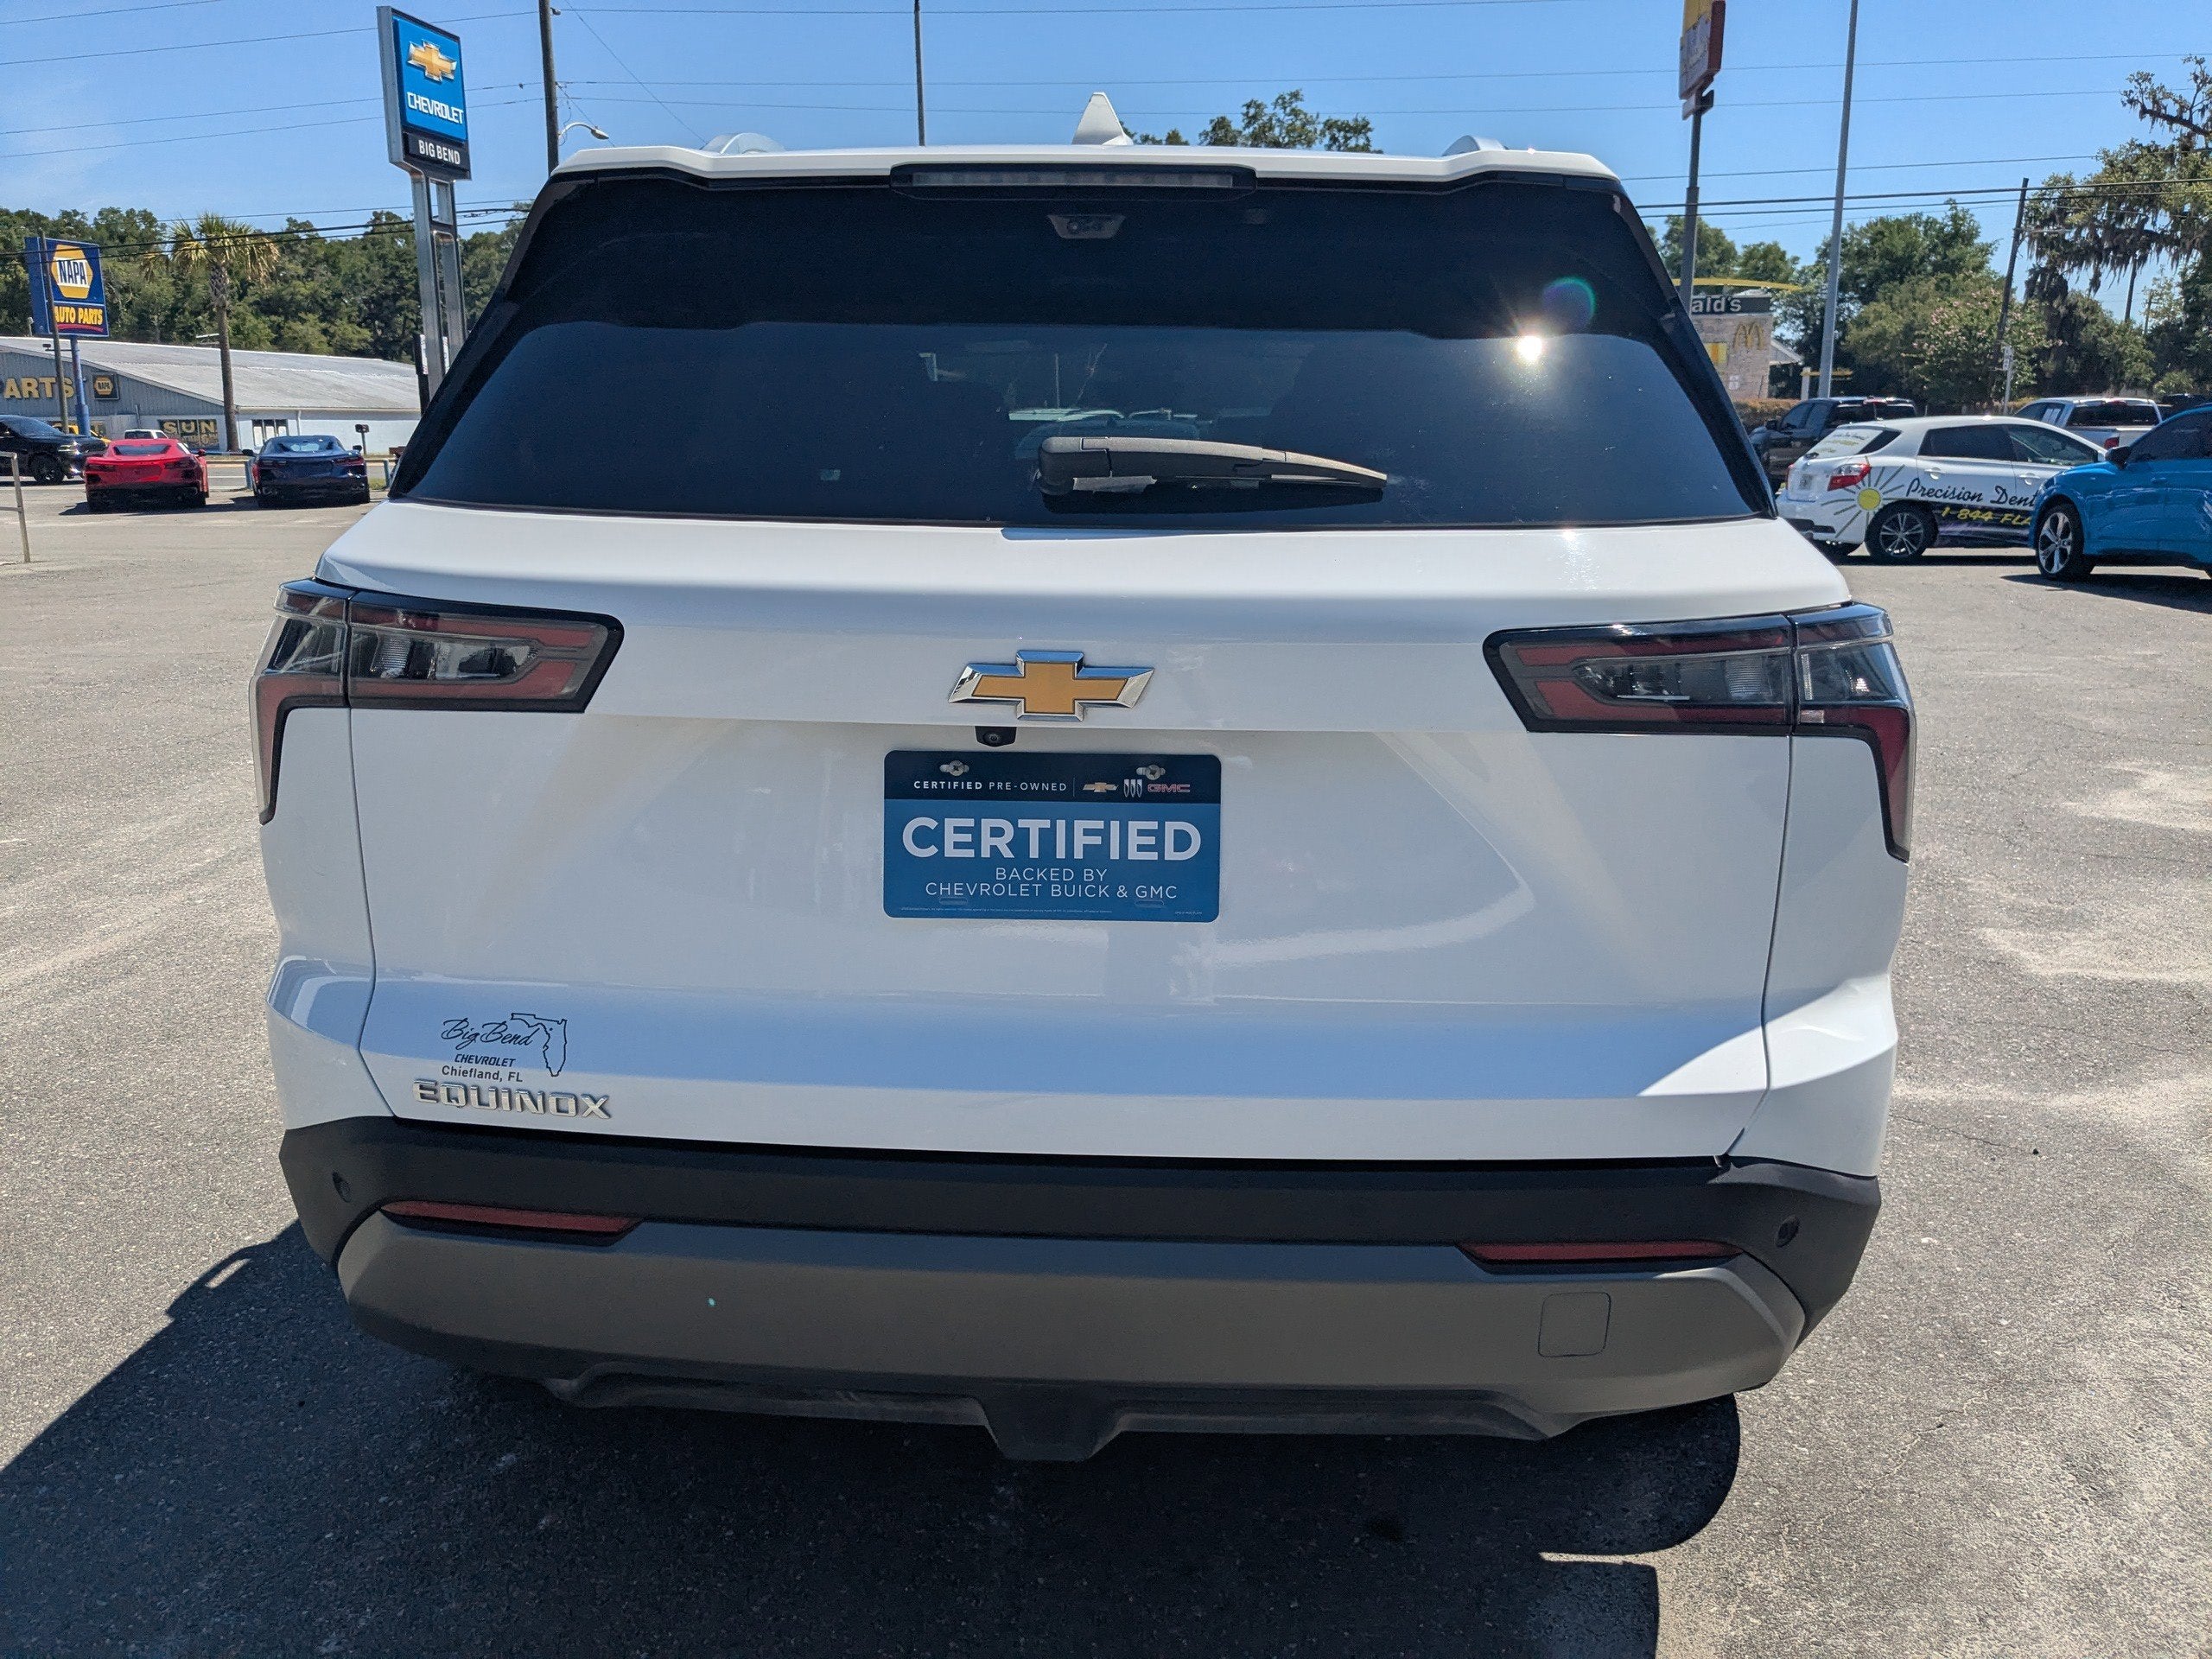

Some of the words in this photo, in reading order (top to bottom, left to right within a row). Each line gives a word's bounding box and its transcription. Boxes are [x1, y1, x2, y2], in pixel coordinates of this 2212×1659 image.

[407, 92, 463, 124] CHEVROLET
[418, 139, 435, 157] BIG
[436, 144, 461, 164] BEND
[58, 260, 87, 285] NAPA
[78, 308, 103, 326] PARTS
[162, 421, 215, 434] SUN
[1905, 477, 1984, 502] Precision
[913, 779, 983, 791] CERTIFIED
[988, 781, 1067, 791] PRE-OWNED
[1147, 783, 1191, 793] GMC
[902, 817, 1202, 861] CERTIFIED
[995, 867, 1075, 881] BACKED
[1084, 868, 1108, 881] BY
[925, 882, 1042, 898] CHEVROLET
[1051, 883, 1110, 898] BUICK
[1116, 885, 1128, 899] &
[1135, 885, 1177, 899] GMC
[441, 1018, 478, 1051] Big
[480, 1020, 540, 1046] Bend
[454, 1053, 517, 1068] CHEVROLET
[442, 1065, 503, 1083] Chiefland,
[508, 1071, 524, 1083] FL
[412, 1078, 612, 1120] EQUINOX
